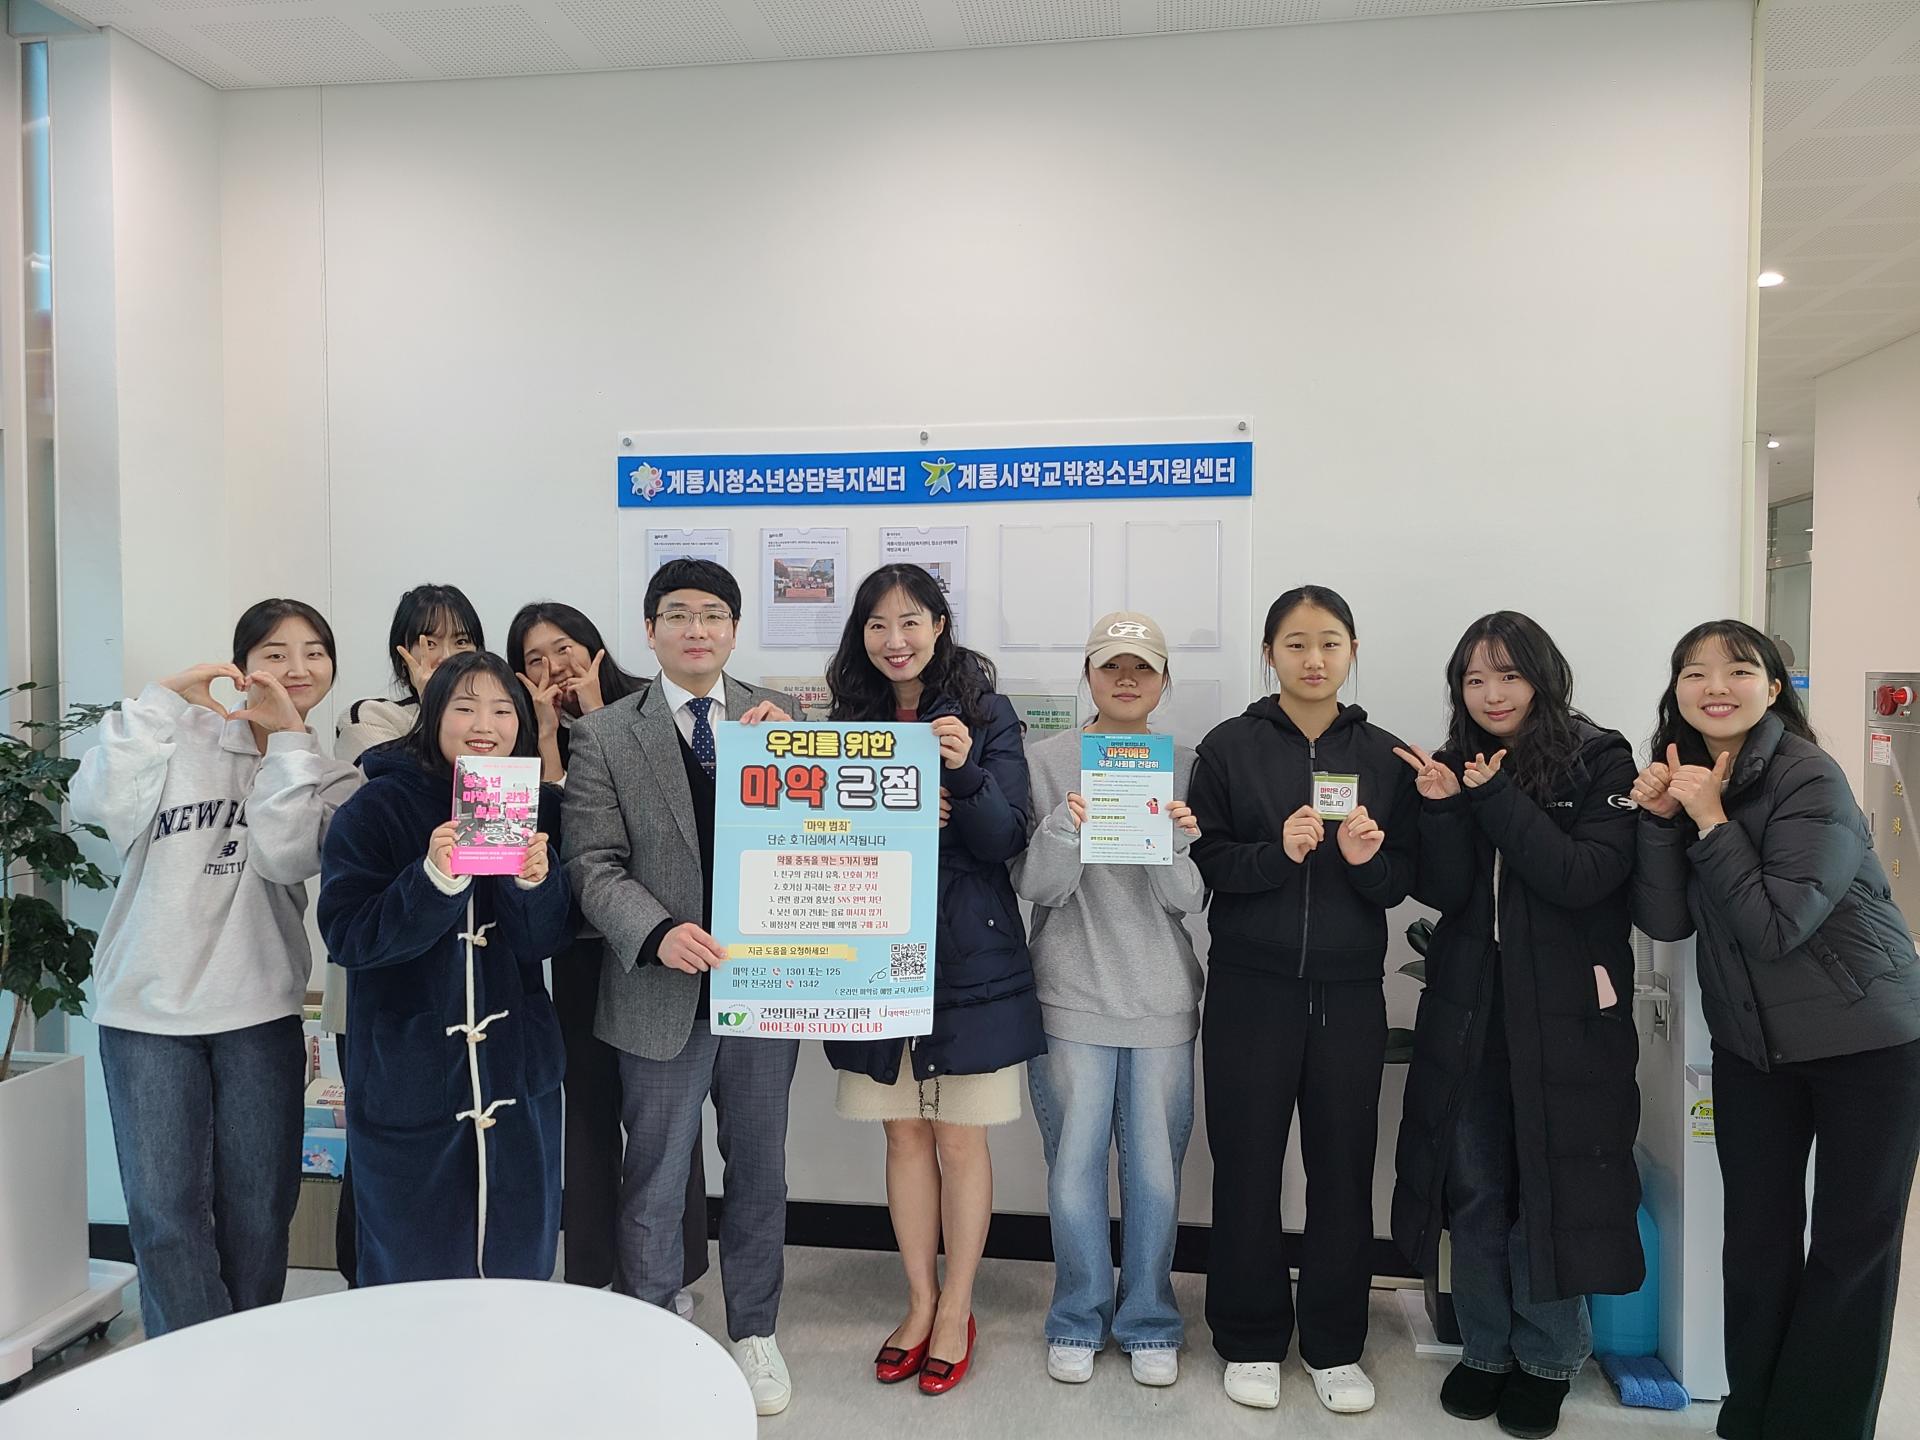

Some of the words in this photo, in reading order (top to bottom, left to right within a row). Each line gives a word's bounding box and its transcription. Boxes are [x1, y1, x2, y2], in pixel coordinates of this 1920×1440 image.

[666, 465, 906, 494] 계룡시청소년상담복지센터
[957, 457, 1236, 490] 계룡시학교밖청소년지원센터
[766, 730, 841, 758] 우리를
[844, 730, 897, 758] 위한
[1106, 746, 1151, 760] 마약예방
[1098, 759, 1113, 768] 우리
[1114, 760, 1136, 769] 사회를
[740, 764, 827, 810] 마약
[836, 765, 922, 811] 근절
[462, 791, 501, 804] 마약에
[505, 790, 530, 804] 관한
[1320, 799, 1344, 807] 아닙니다
[152, 798, 226, 844] NEW
[768, 834, 786, 846] 단순
[789, 834, 836, 846] 호기심에서
[839, 835, 887, 847] 시작됩니다
[777, 855, 792, 866] 약물
[795, 855, 818, 866] 중독을
[821, 855, 837, 866] 막는
[839, 855, 860, 866] 5가지
[863, 855, 878, 866] 방법
[781, 870, 801, 879] 친구의
[842, 871, 863, 880] 단호히
[782, 883, 802, 892] 호기심
[805, 883, 831, 892] 자극하는
[833, 883, 847, 892] 광고
[849, 883, 862, 892] 문구
[864, 883, 878, 892] 무시
[777, 896, 791, 904] 관련
[793, 896, 813, 904] 광고와
[838, 896, 851, 904] SNS
[868, 896, 882, 905] 차단
[809, 908, 829, 917] 건네는
[831, 908, 844, 917] 음료
[846, 908, 866, 917] 마시지
[799, 921, 819, 929] 온라인
[838, 921, 857, 929] 의약품
[875, 921, 888, 929] 금지
[748, 946, 763, 955] 지금
[765, 946, 787, 955] 도움을
[789, 946, 829, 955] 요청하세요!
[732, 967, 748, 976] 마약
[751, 967, 767, 976] 신고
[786, 968, 805, 976] 1301
[807, 967, 823, 976] 또는
[826, 968, 841, 976] 125
[732, 979, 748, 988] 마약
[751, 979, 782, 988] 전국상담
[799, 980, 820, 988] 1342
[840, 988, 858, 996] 온라인
[894, 987, 906, 995] 교육
[907, 985, 925, 994] 사이트
[759, 1007, 821, 1020] 건양대학교
[823, 1007, 872, 1020] 간호대학
[759, 1021, 805, 1033] 아이조아
[808, 1021, 849, 1034] STUDY
[851, 1022, 883, 1034] CLUB
